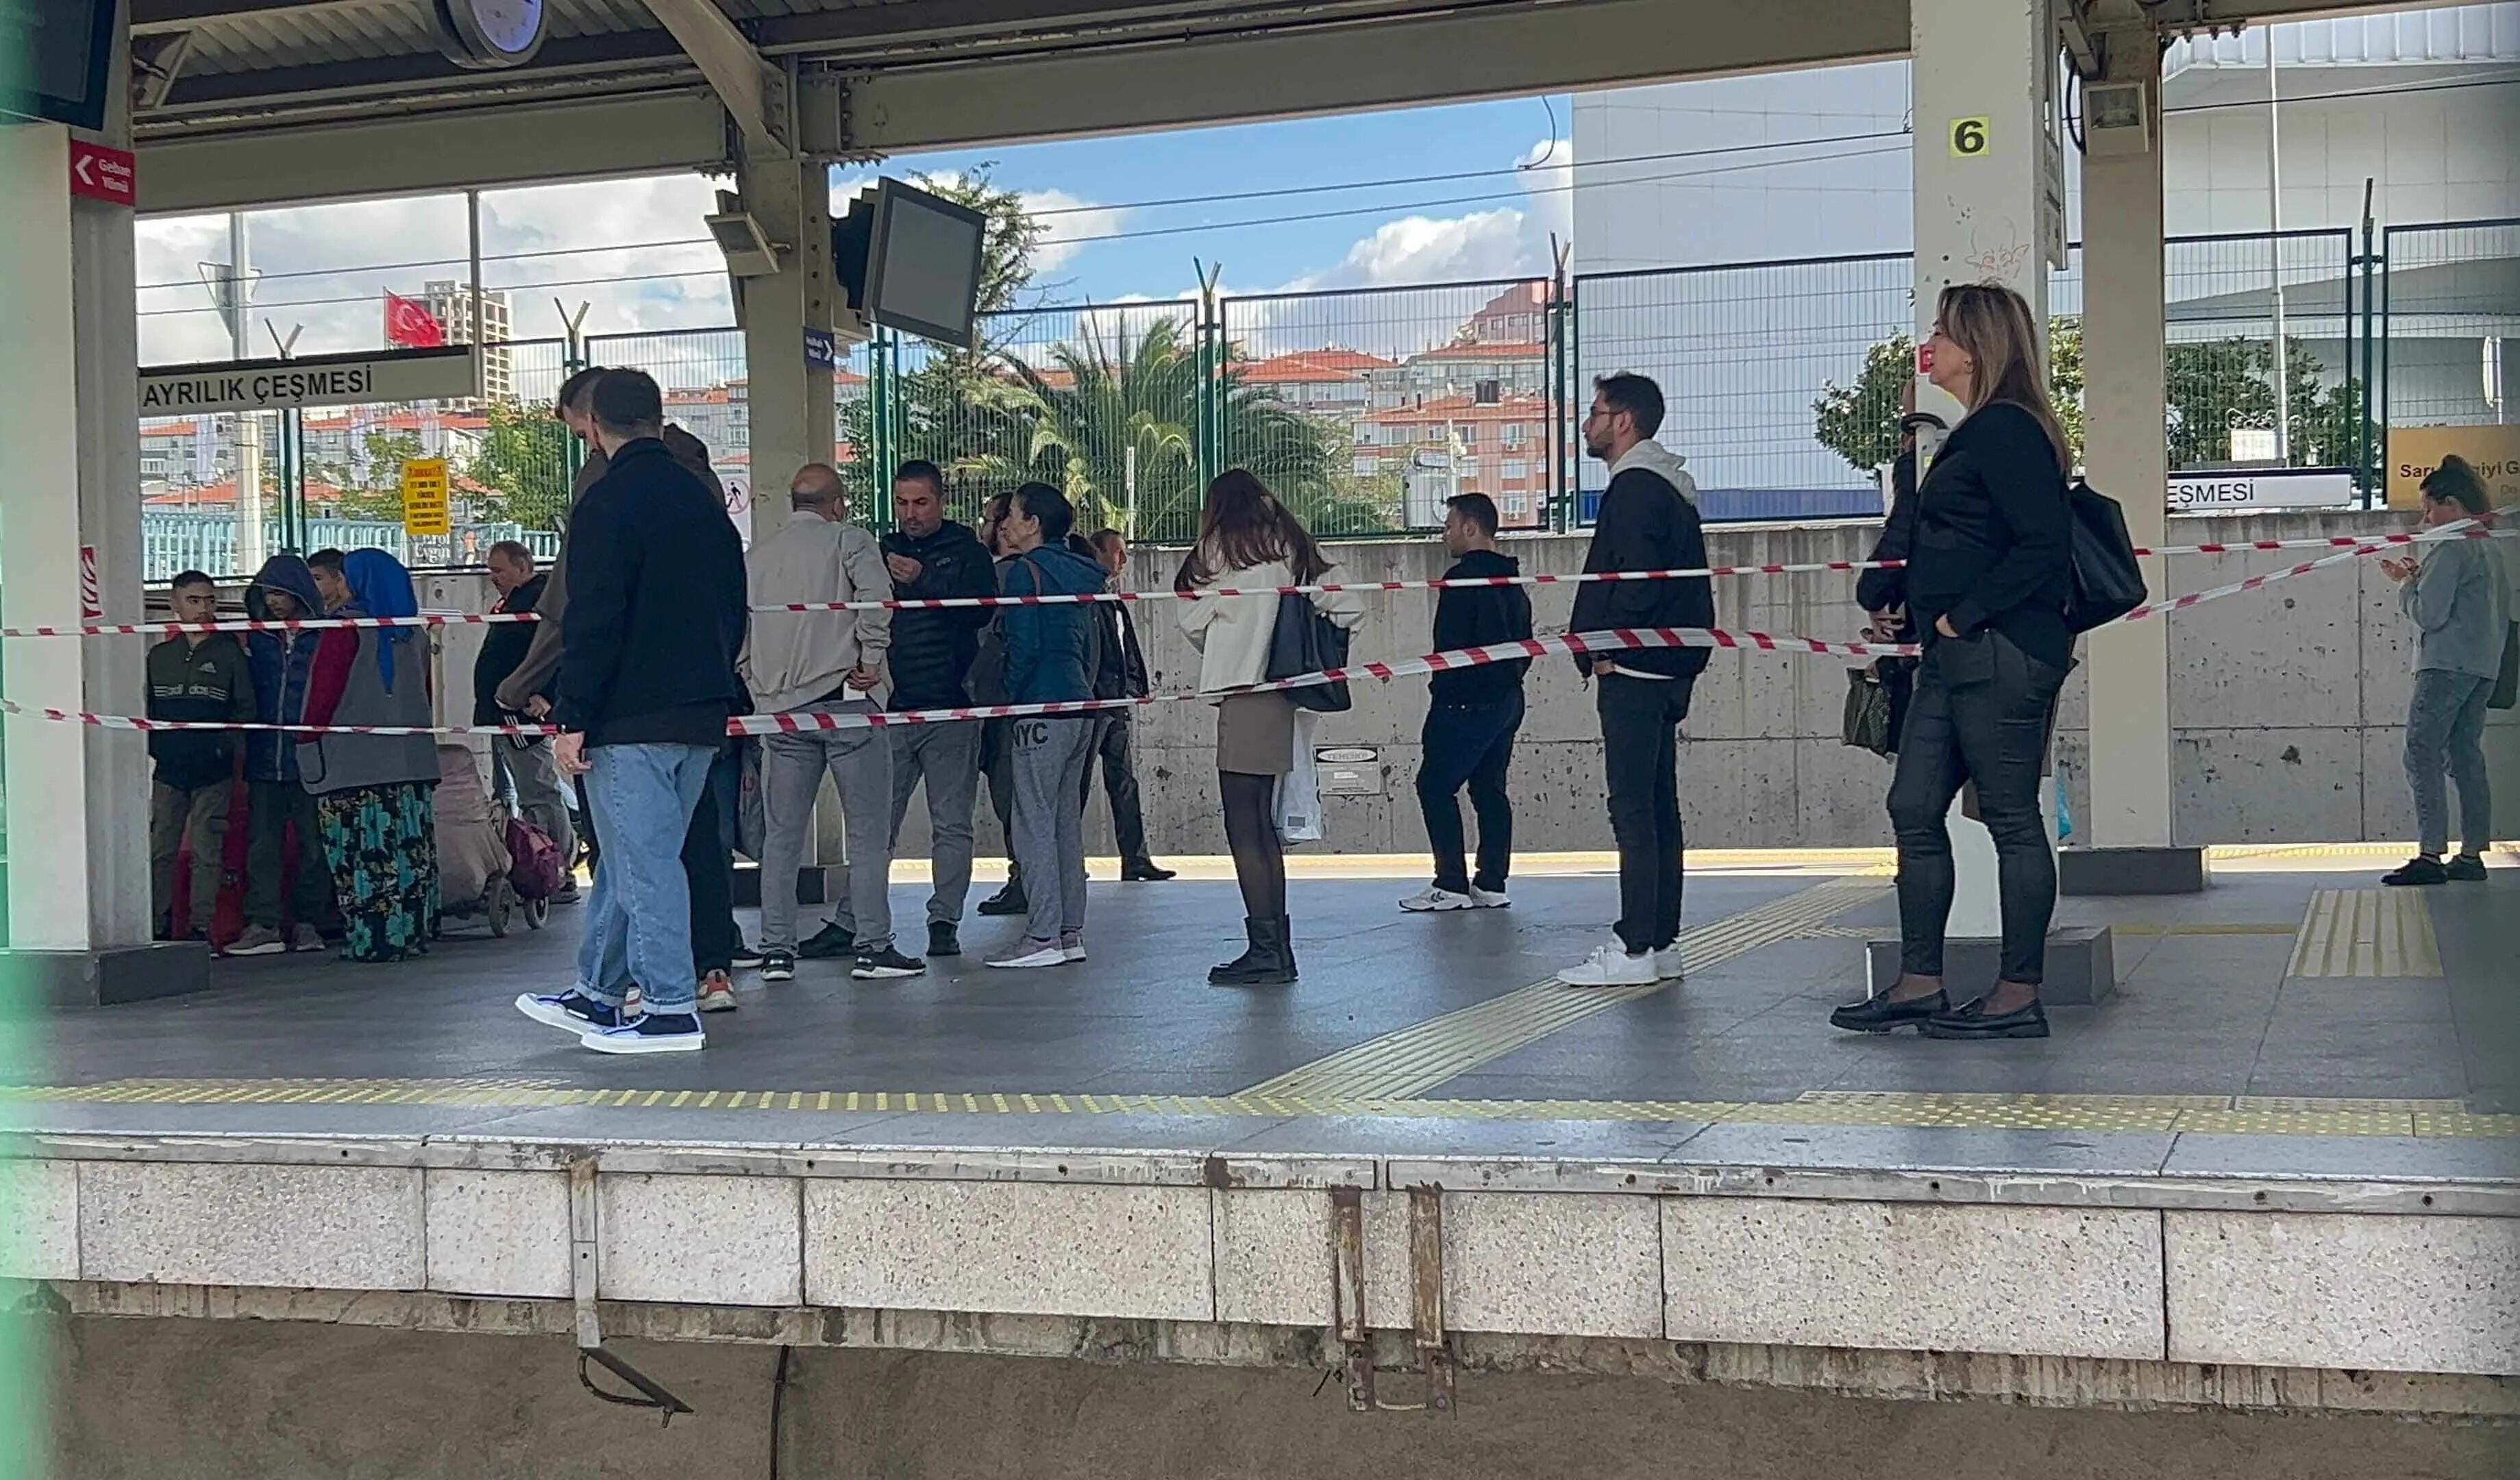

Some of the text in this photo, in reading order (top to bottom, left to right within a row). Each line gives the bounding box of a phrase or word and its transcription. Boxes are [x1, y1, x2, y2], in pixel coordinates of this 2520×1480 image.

[1955, 121, 1984, 153] 6
[143, 364, 372, 407] AYRILIK ÇEŞMESİ
[2167, 478, 2253, 508] EŞMESİ
